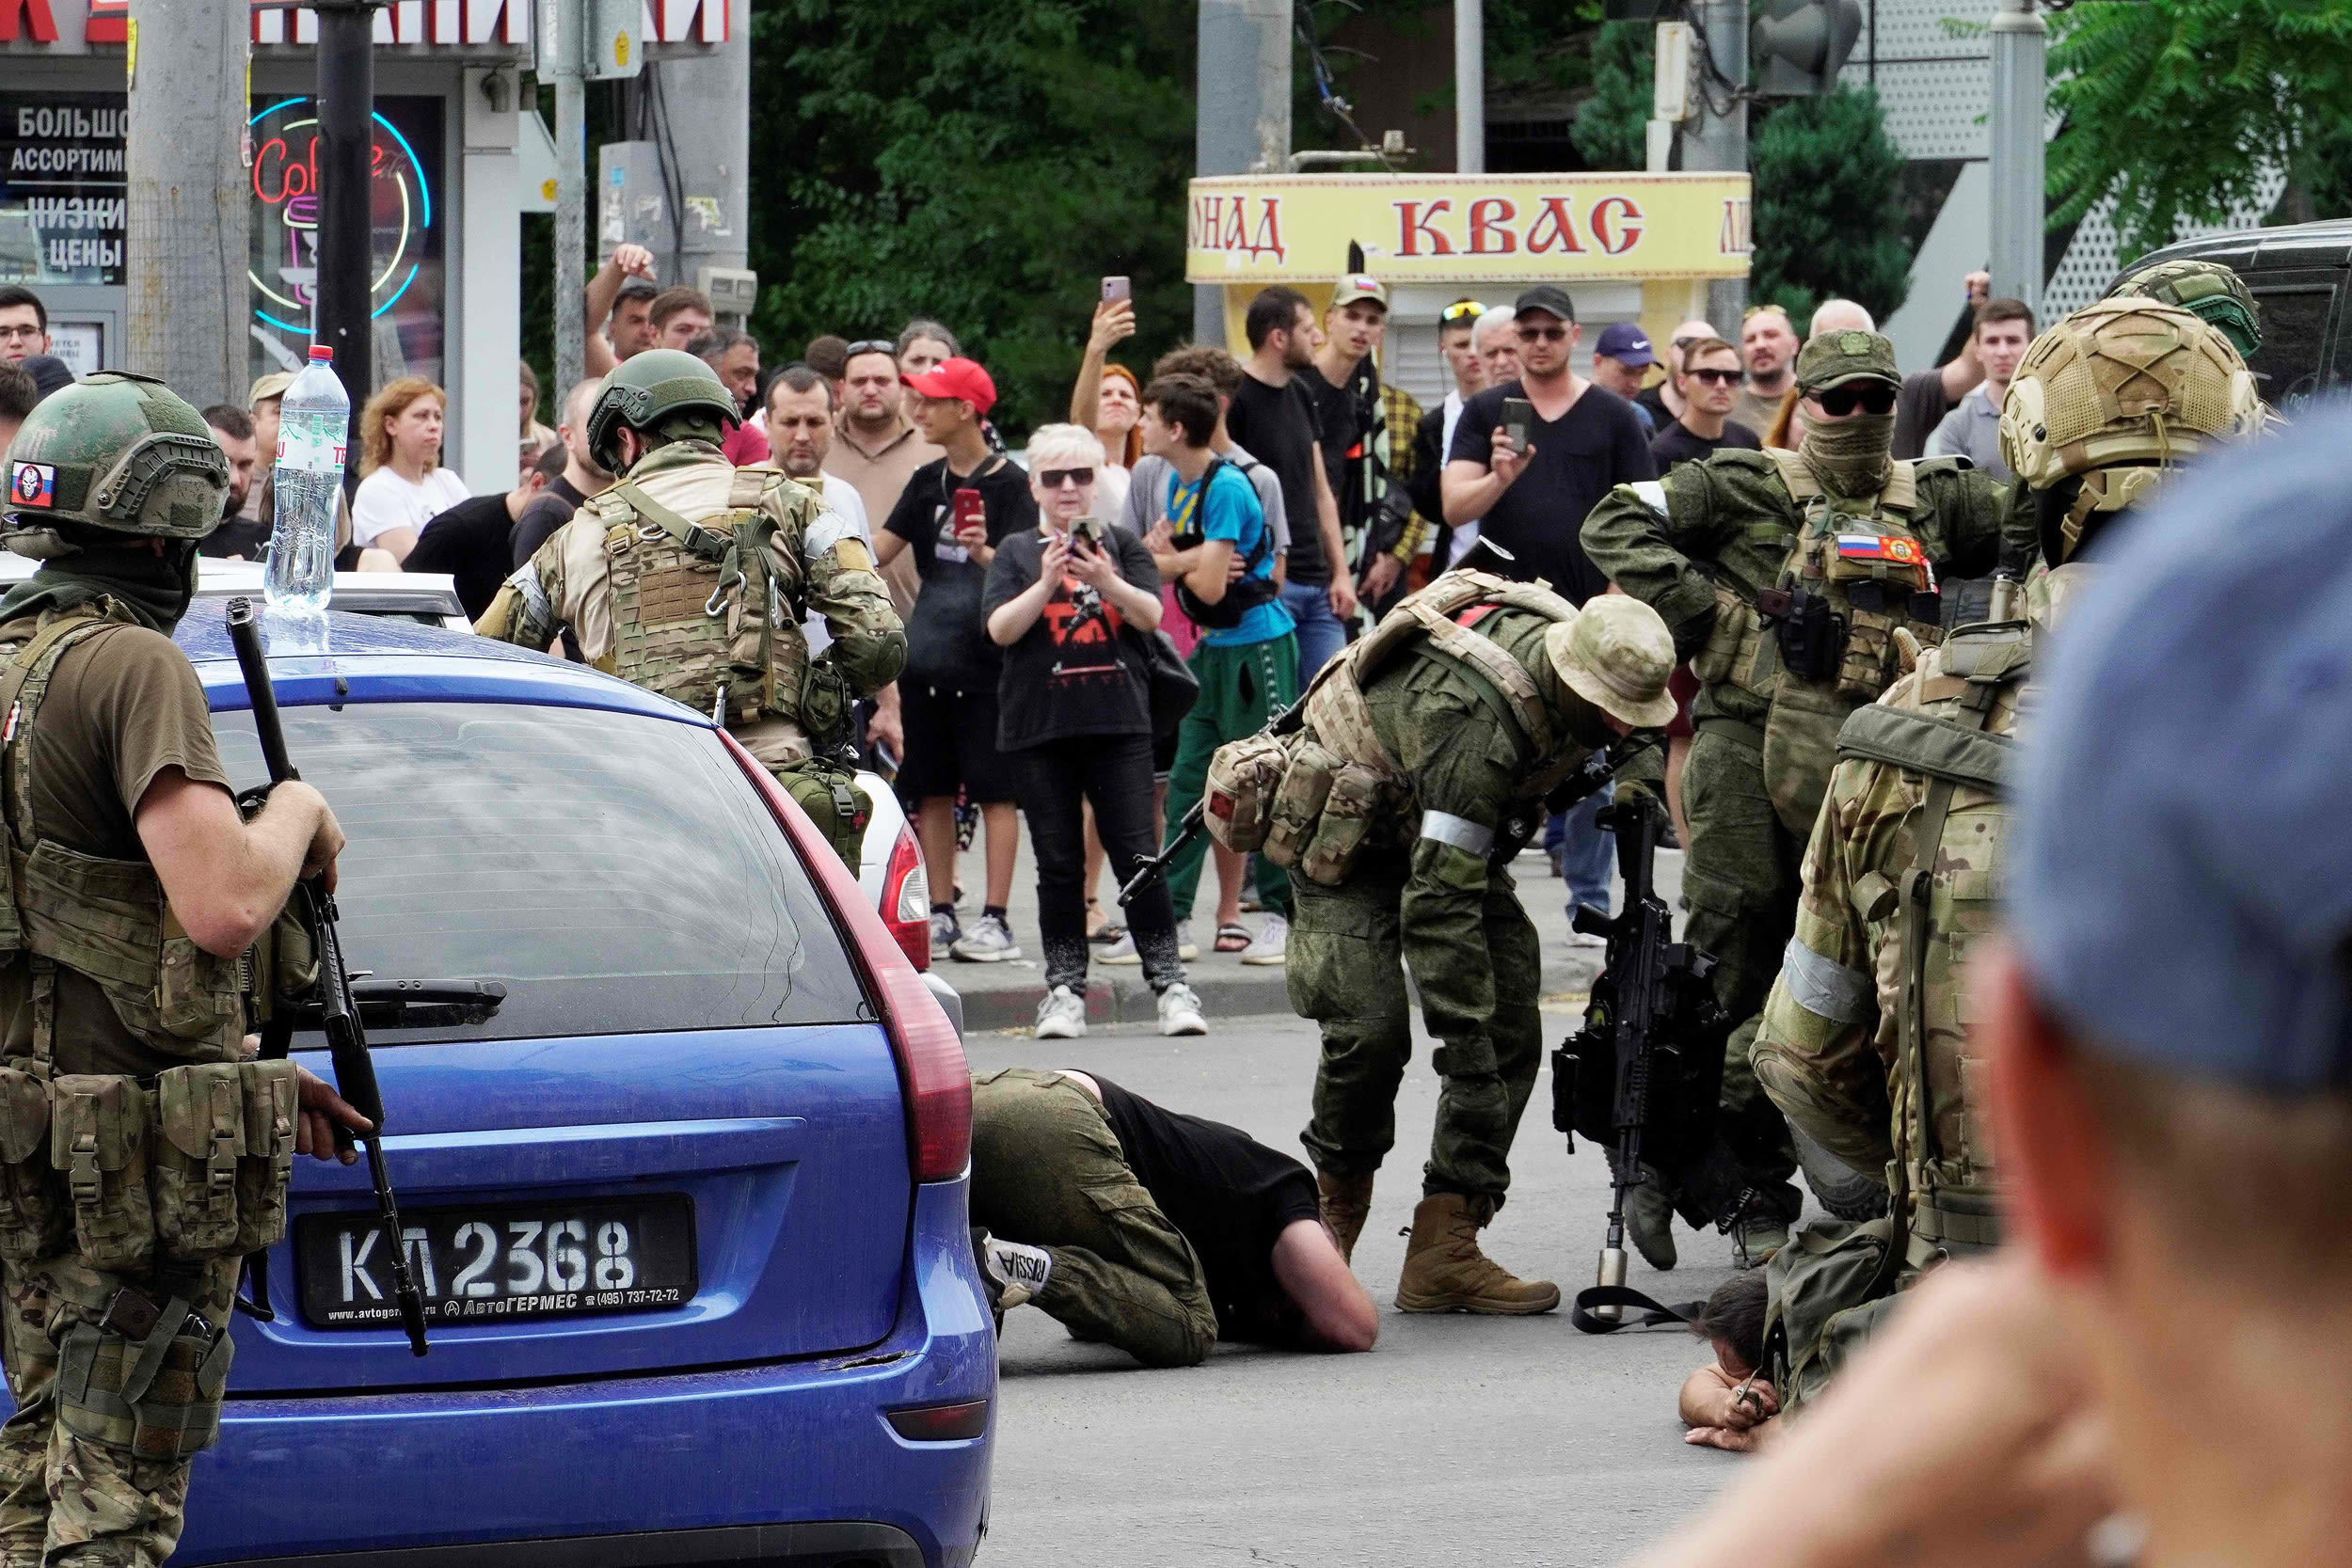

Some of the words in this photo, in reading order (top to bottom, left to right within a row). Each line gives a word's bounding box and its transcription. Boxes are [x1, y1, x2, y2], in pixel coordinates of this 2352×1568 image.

[18, 107, 129, 137] БОЛЬШО
[10, 148, 129, 172] АССОРТИМ
[27, 197, 126, 230] НИЗКИ
[1392, 198, 1644, 256] КВАС
[1189, 196, 1284, 264] ОНАД
[50, 239, 121, 271] ЦЕНЫ
[596, 1290, 624, 1307] (495)
[627, 1289, 679, 1304] 737-72-72
